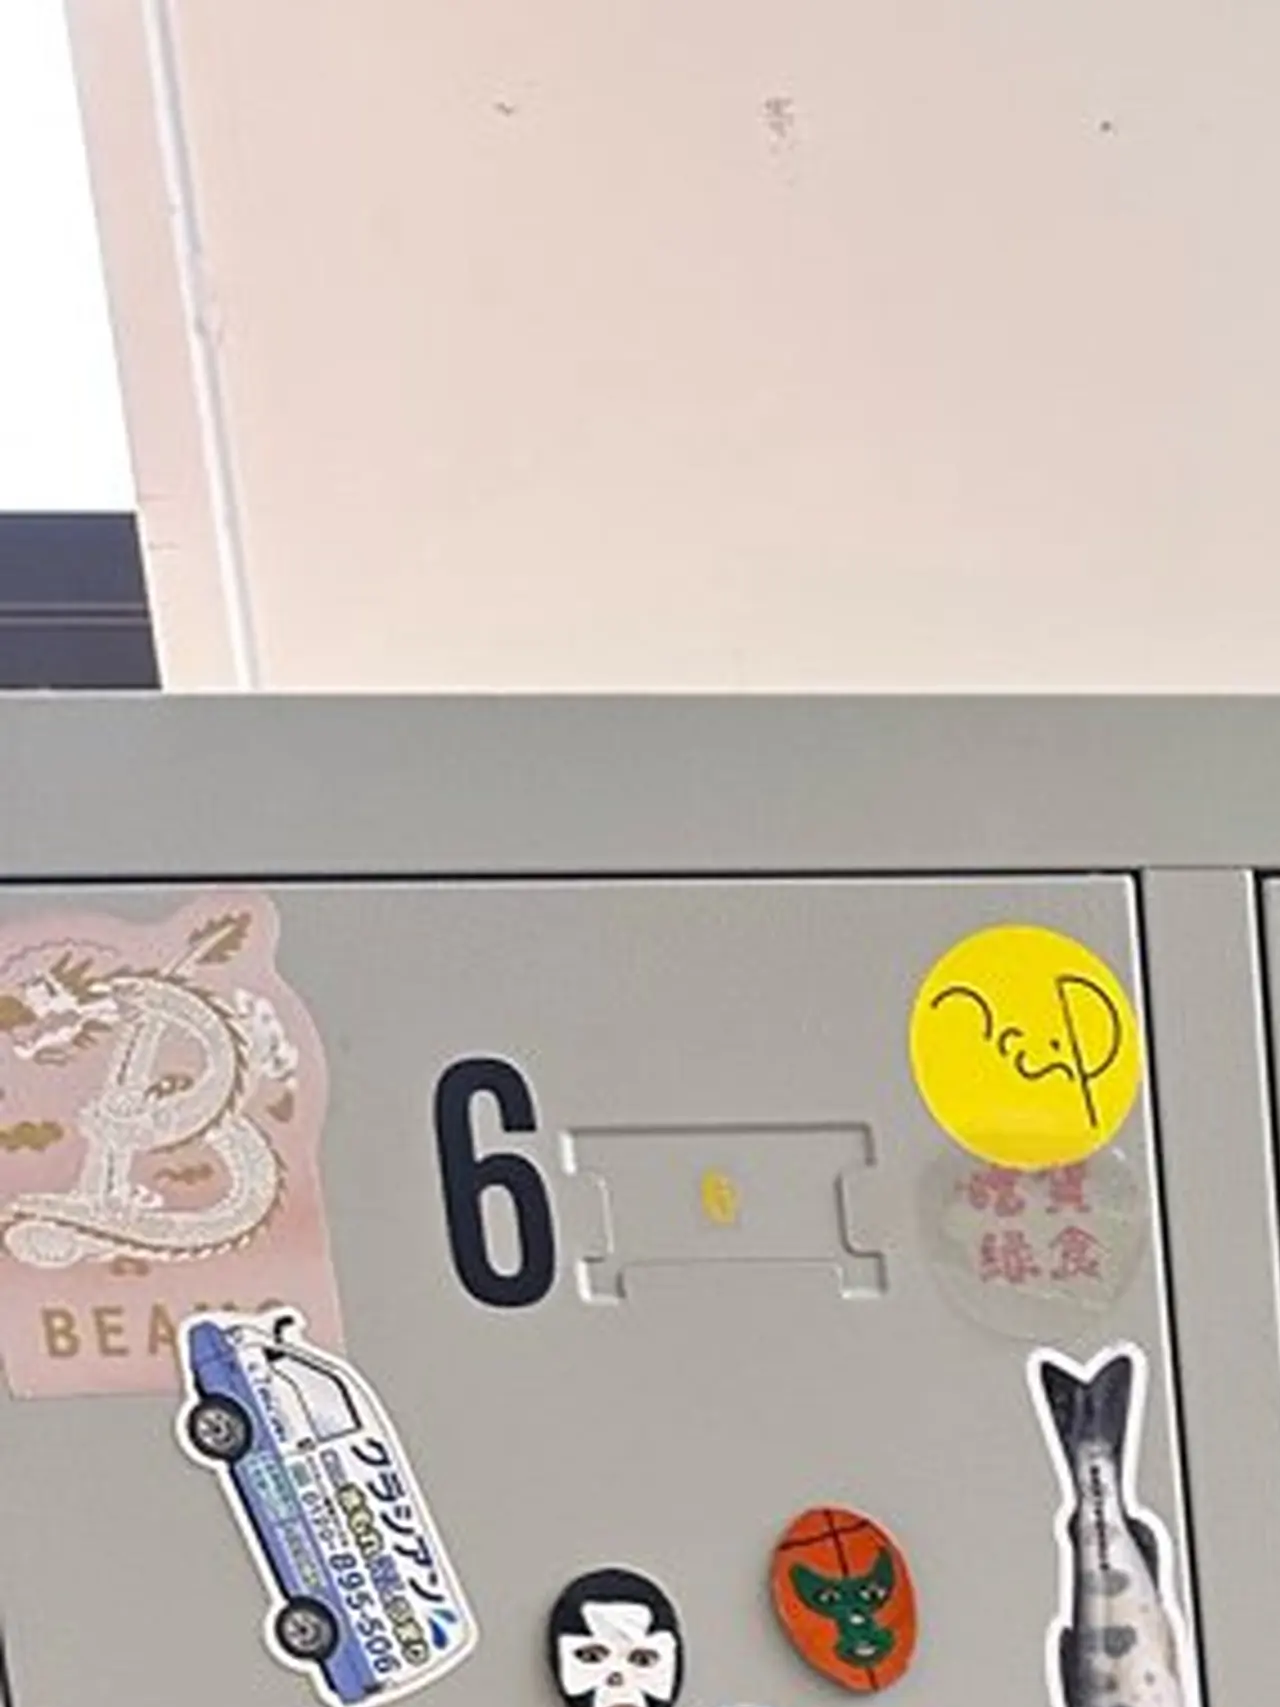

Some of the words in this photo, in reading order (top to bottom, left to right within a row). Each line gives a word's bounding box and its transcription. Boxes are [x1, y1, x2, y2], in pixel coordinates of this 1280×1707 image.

[434, 1057, 557, 1308] 6
[351, 1437, 445, 1603] クラシアン
